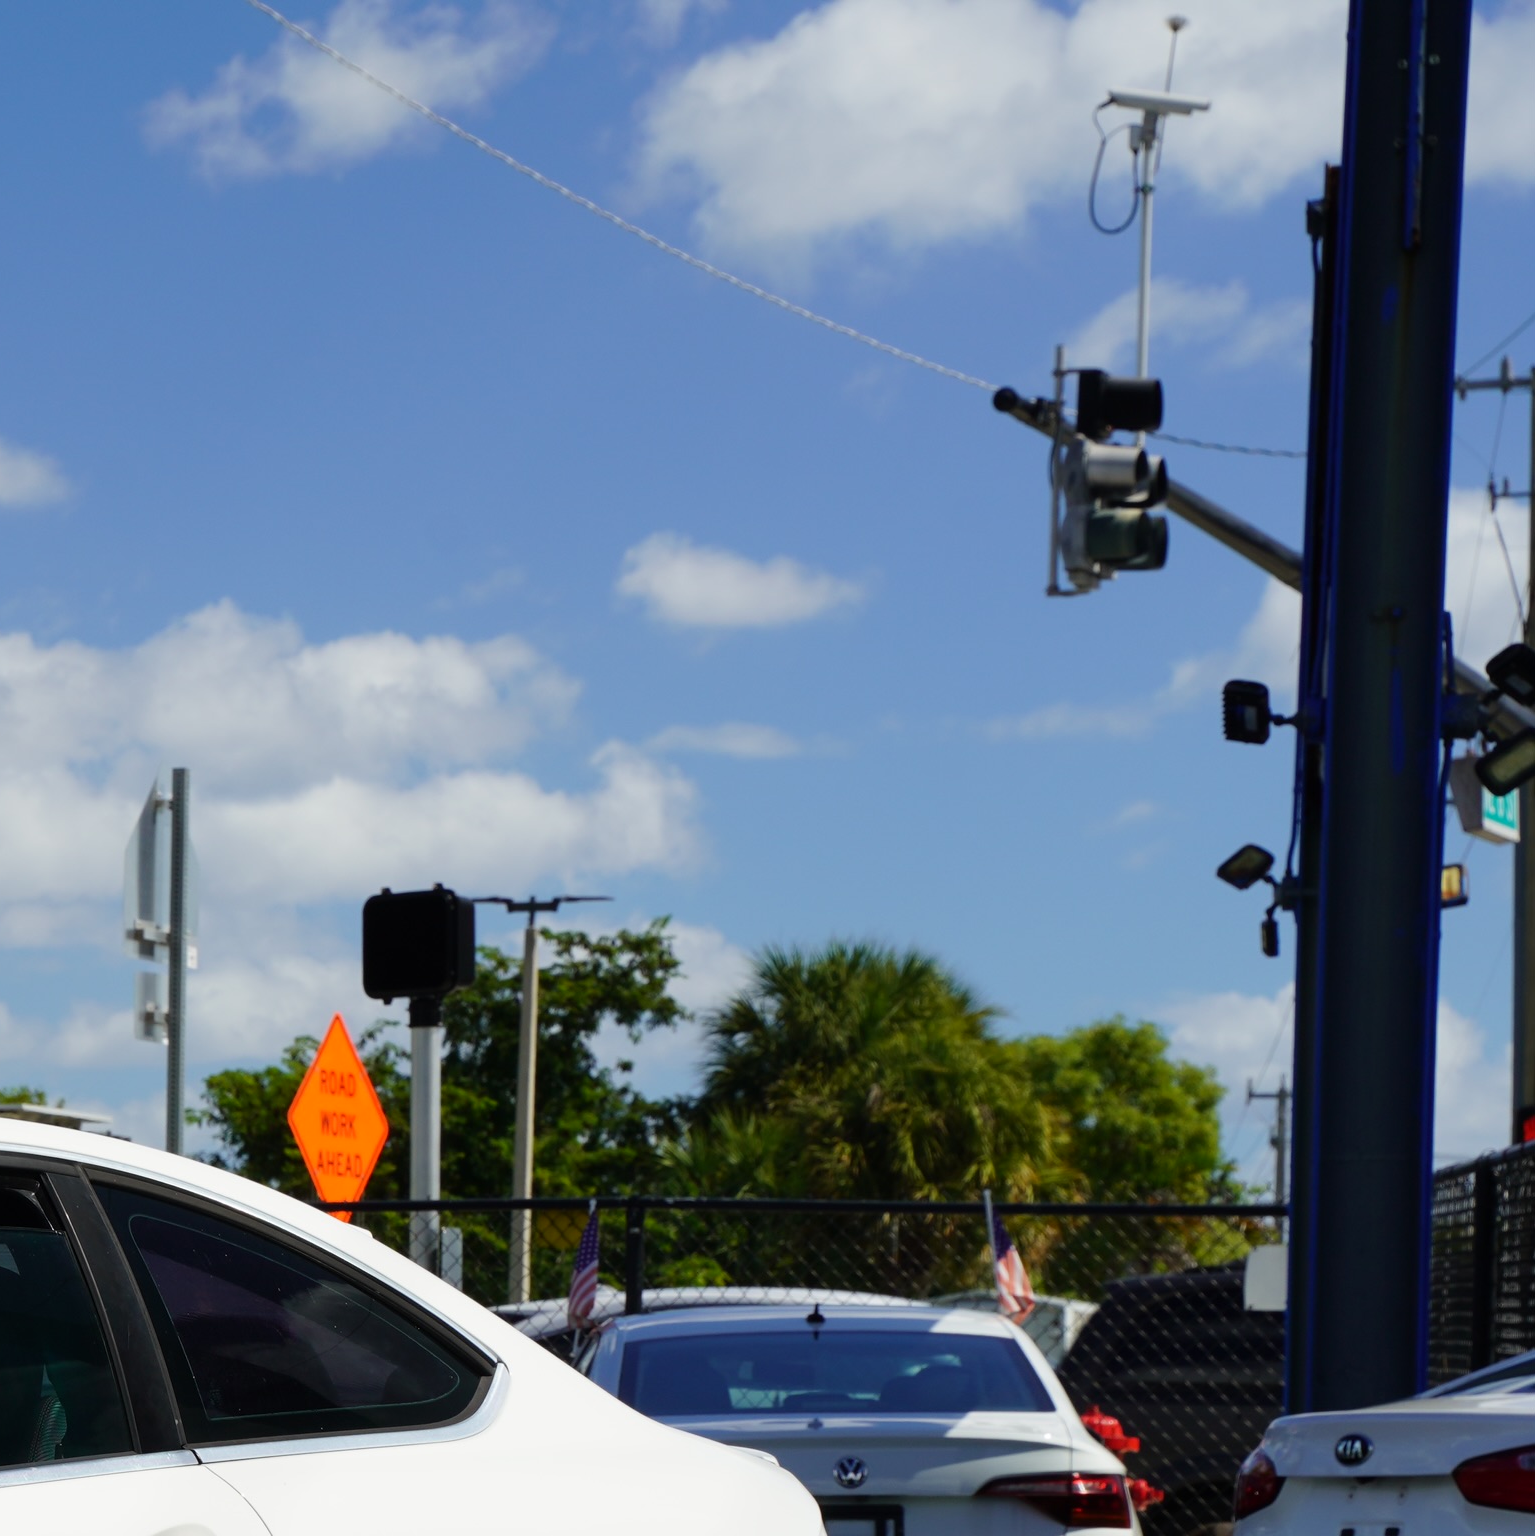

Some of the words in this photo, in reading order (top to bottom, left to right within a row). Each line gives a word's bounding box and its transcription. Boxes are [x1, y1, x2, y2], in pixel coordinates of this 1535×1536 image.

[320, 1069, 357, 1098] ROAD
[320, 1110, 357, 1140] WORK
[317, 1150, 364, 1178] AHEAD
[1337, 1439, 1363, 1459] KIA
